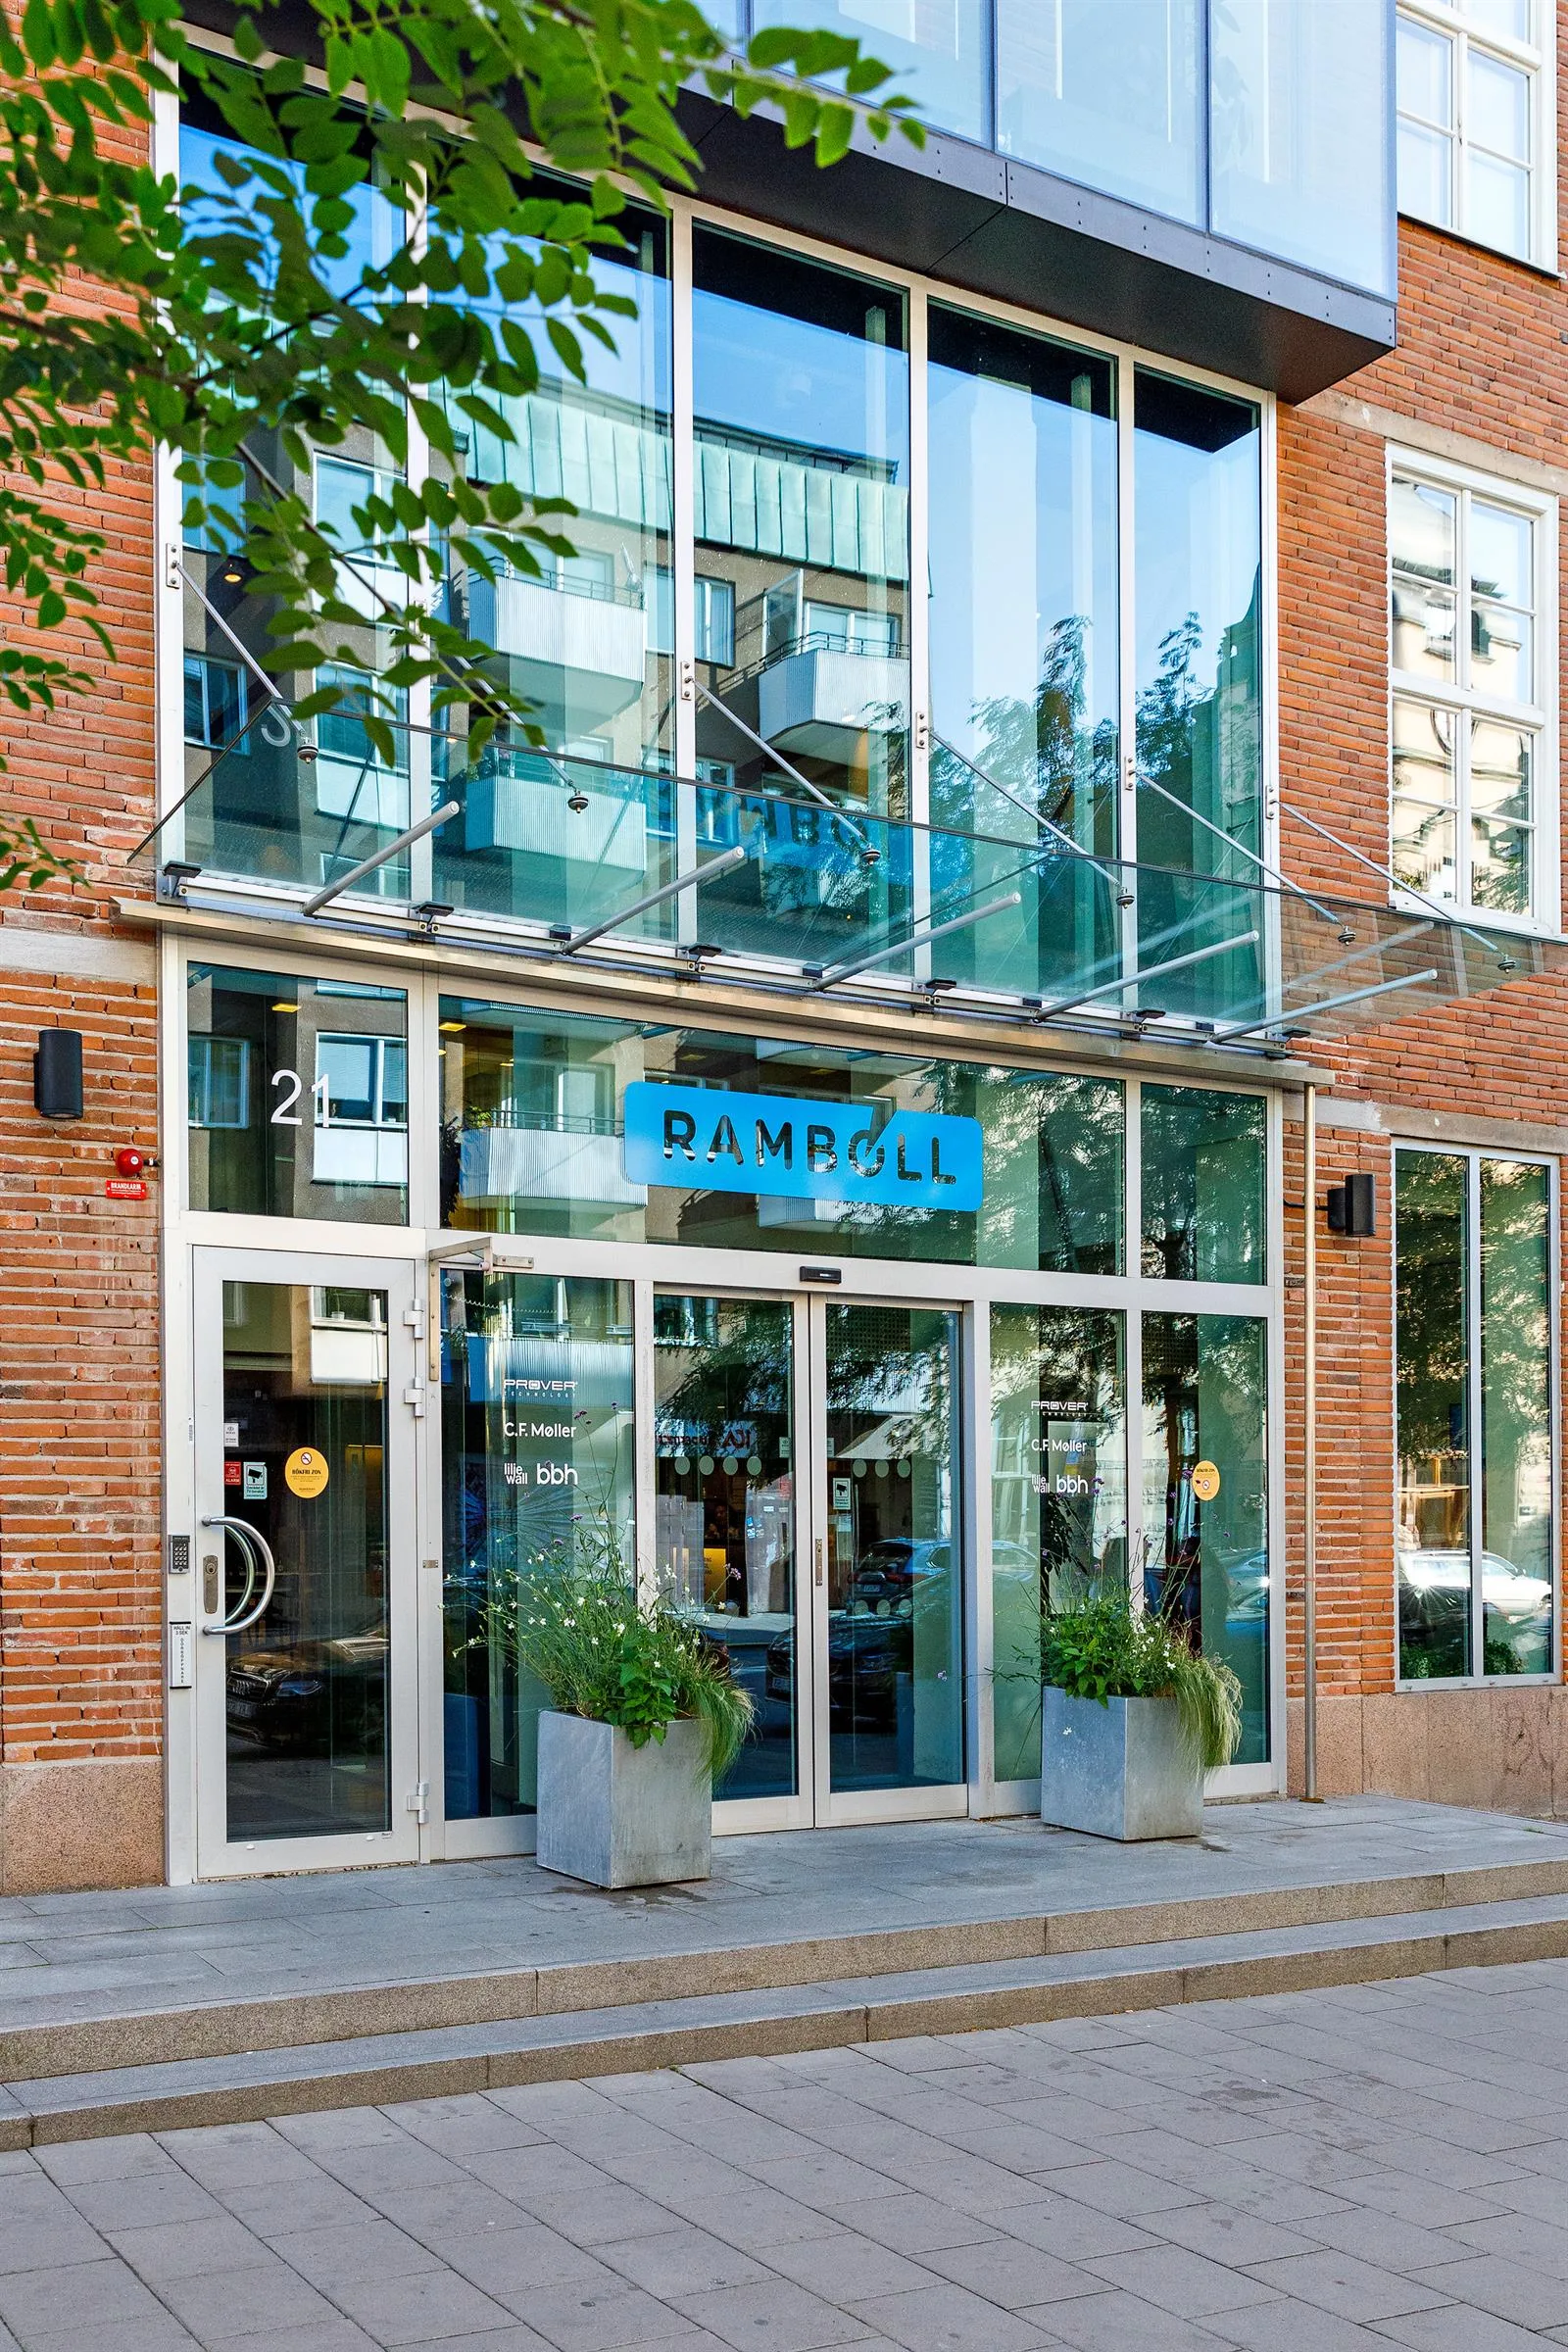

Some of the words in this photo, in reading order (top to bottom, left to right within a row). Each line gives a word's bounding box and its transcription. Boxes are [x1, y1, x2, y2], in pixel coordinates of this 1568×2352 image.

[270, 1069, 329, 1127] 21
[504, 1422, 528, 1437] C.F.
[531, 1423, 577, 1438] Møller
[1031, 1439, 1050, 1451] C.F.
[1052, 1440, 1088, 1452] Møller
[536, 1463, 578, 1485] bbh
[1055, 1474, 1089, 1494] bbh
